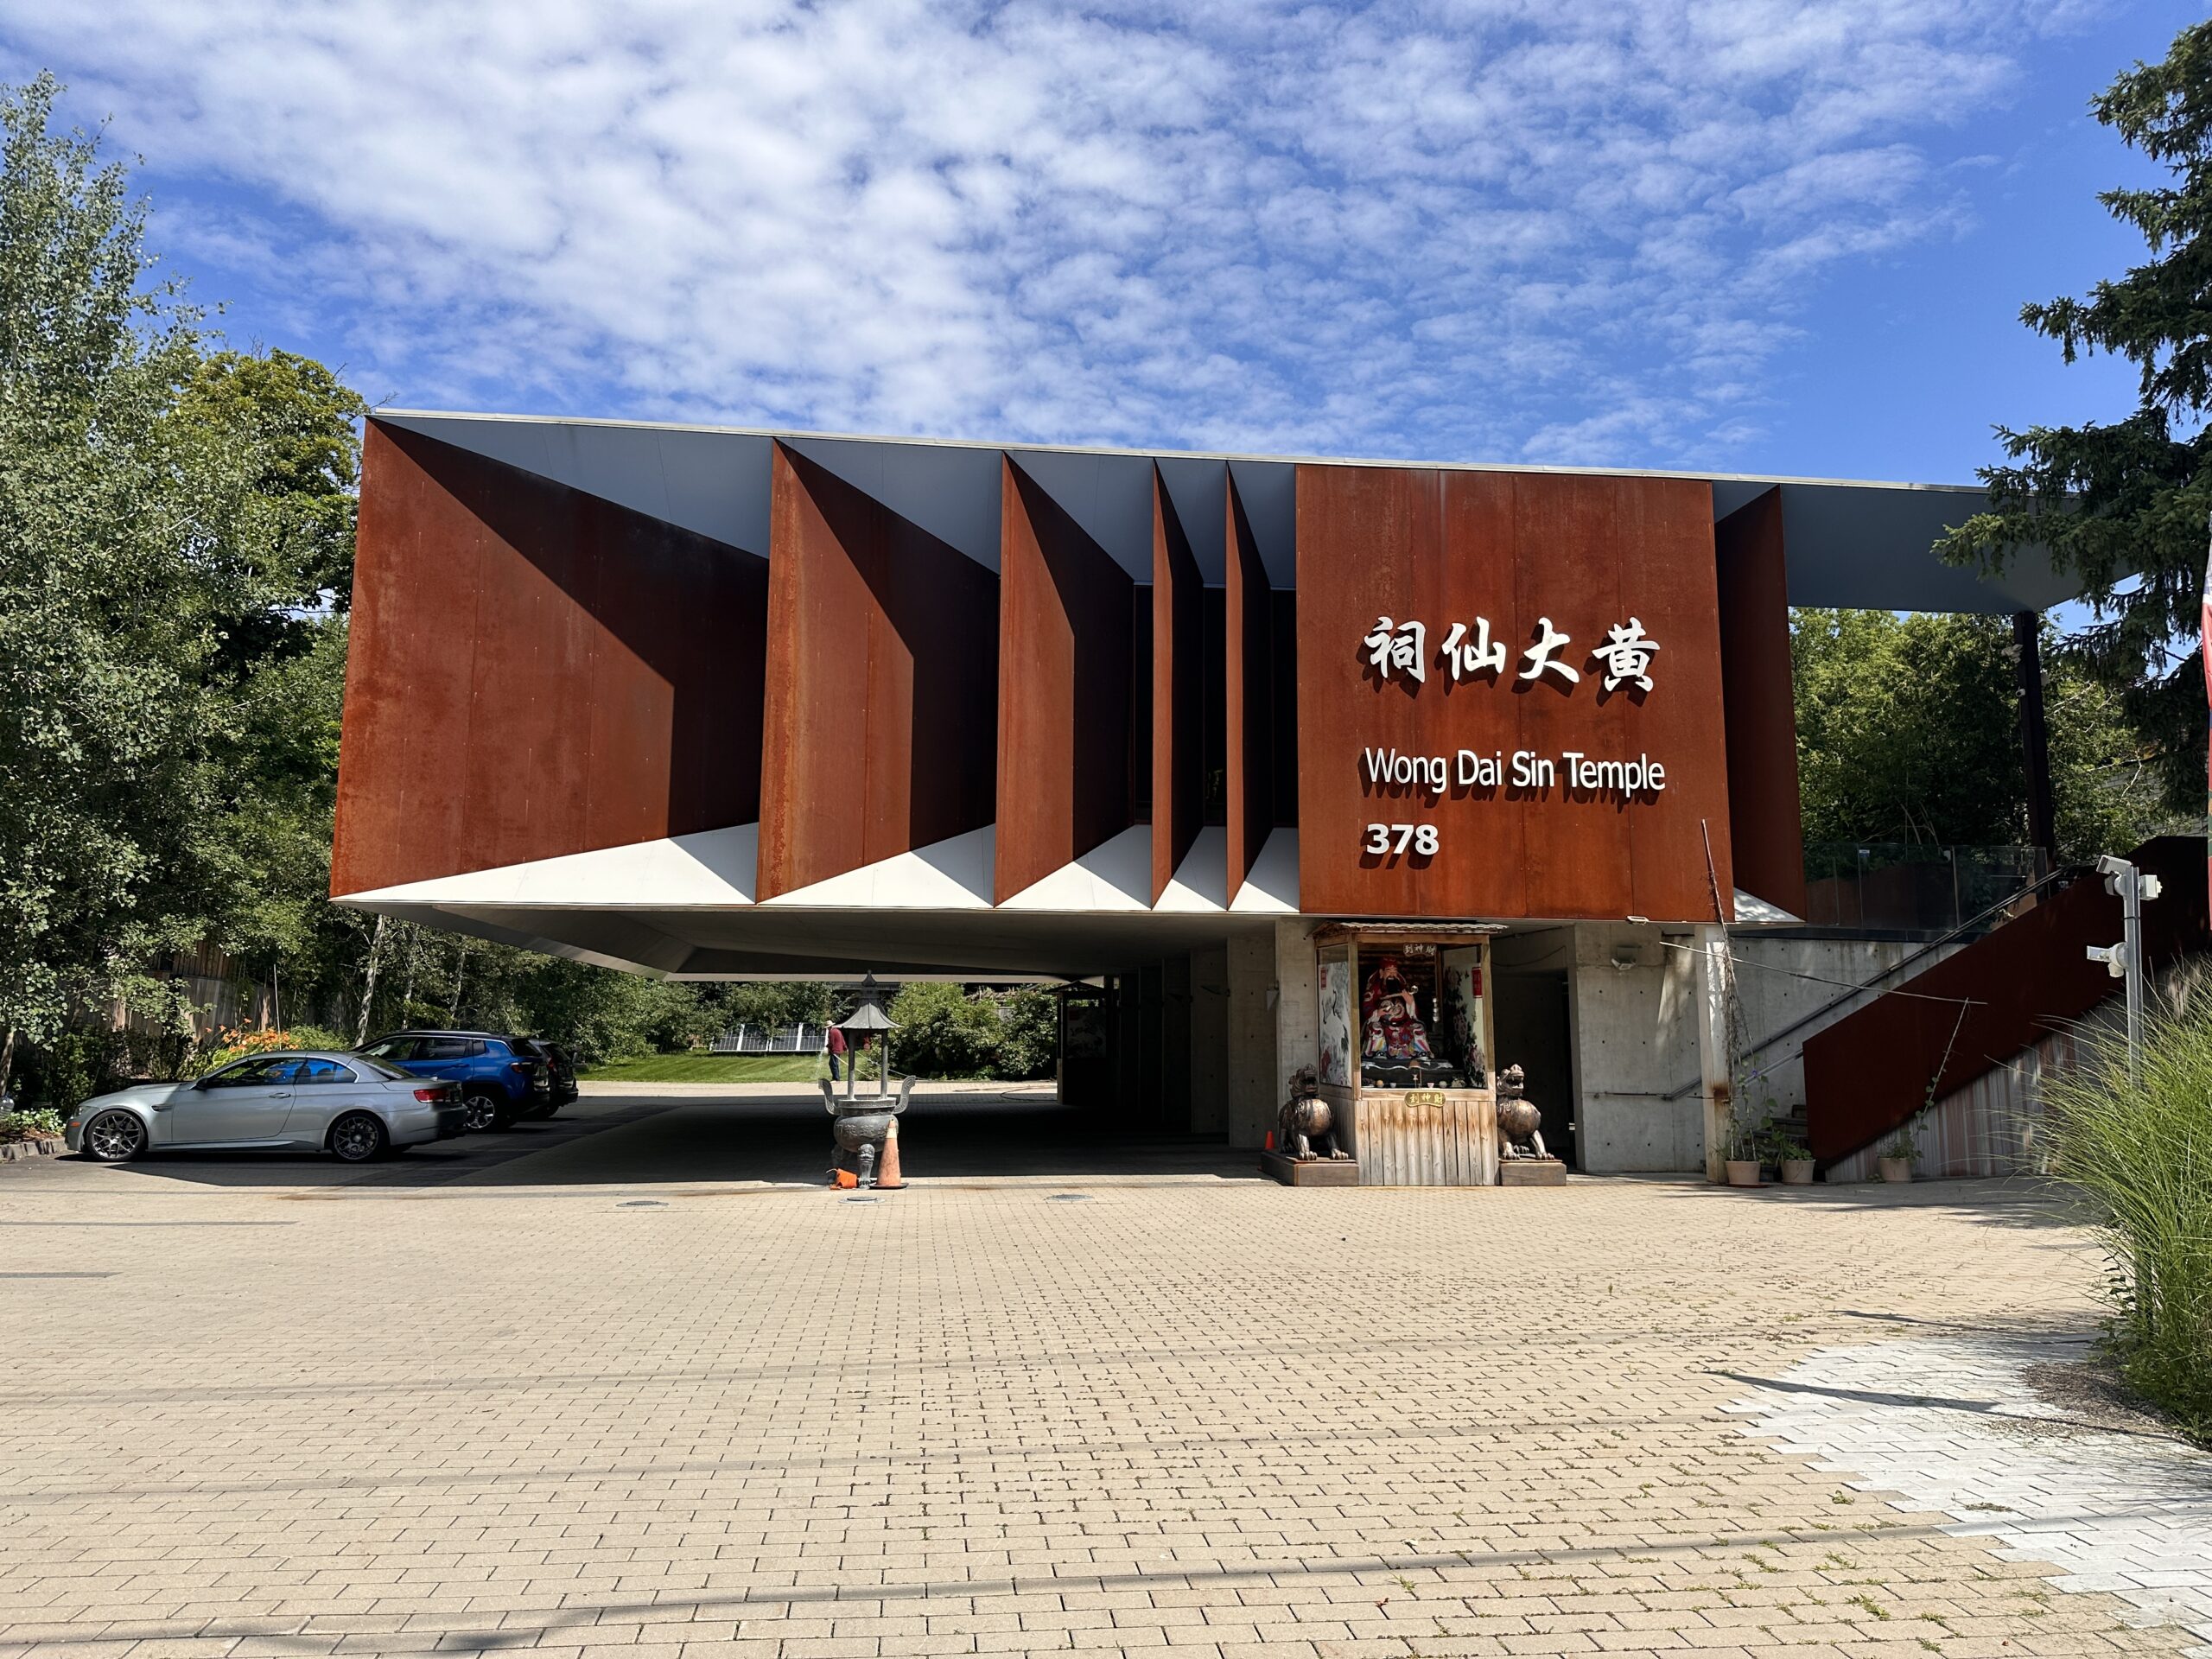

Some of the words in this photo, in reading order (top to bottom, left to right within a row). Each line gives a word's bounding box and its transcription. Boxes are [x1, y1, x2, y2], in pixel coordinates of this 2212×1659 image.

[1365, 747, 1447, 794] Wong
[1458, 749, 1503, 786] Dai
[1512, 750, 1555, 787] Sin
[1562, 752, 1666, 798] Temple
[1366, 823, 1440, 855] 378
